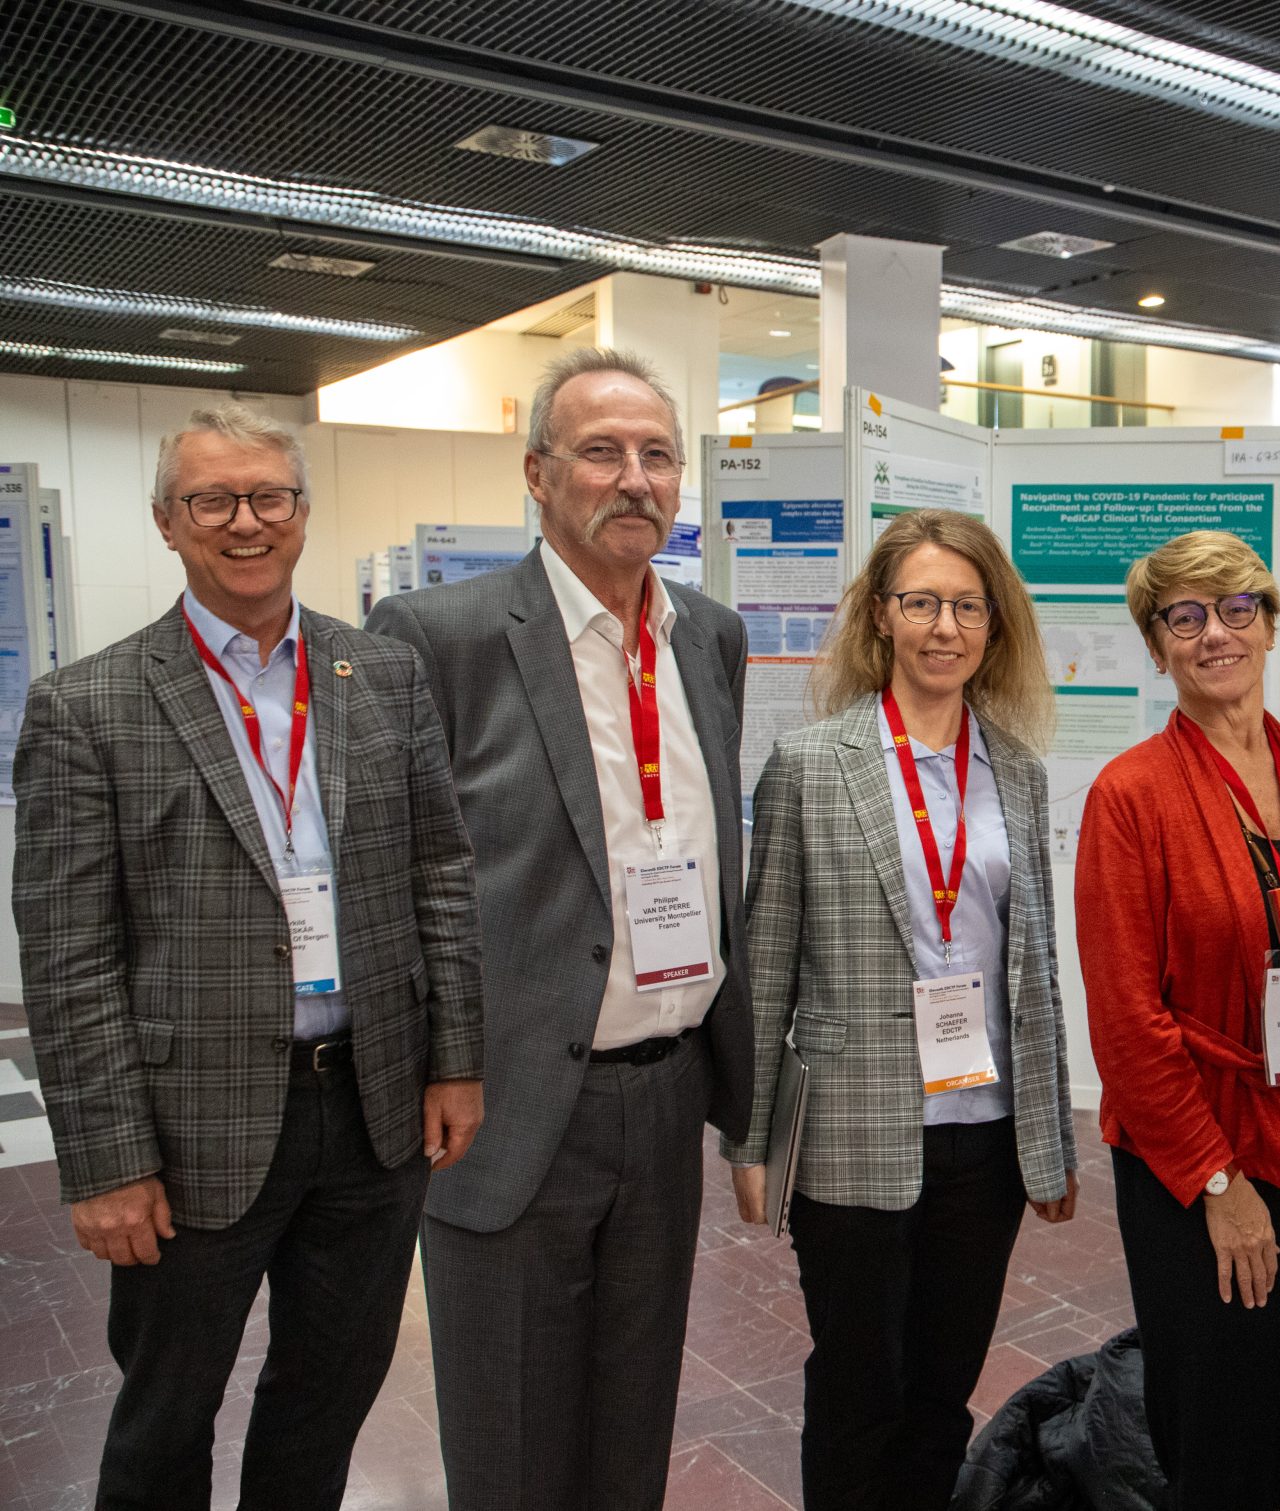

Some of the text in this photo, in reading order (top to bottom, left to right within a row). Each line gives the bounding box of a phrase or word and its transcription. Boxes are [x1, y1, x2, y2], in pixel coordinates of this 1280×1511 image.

[863, 421, 888, 439] PA-154
[720, 459, 761, 470] PA-152
[1020, 492, 1070, 502] Navigating
[1092, 492, 1139, 500] COVID-19
[1142, 492, 1189, 500] Pandemic
[1193, 492, 1206, 500] for
[1210, 492, 1263, 502] Participant
[1022, 503, 1261, 514] Recruitment and Follow-up: Experiences from the
[1060, 514, 1220, 522] PediCAP Clinical Trial Consortium
[654, 896, 678, 904] Philippe
[668, 902, 690, 911] PERRE
[634, 910, 702, 925] University Montpellier
[658, 922, 680, 930] France
[663, 969, 688, 978] SPEAKER
[940, 1012, 963, 1020] Johanna
[936, 1018, 968, 1028] SCHAEFER
[942, 1026, 962, 1034] EDCTP
[936, 1033, 970, 1044] Netherlands
